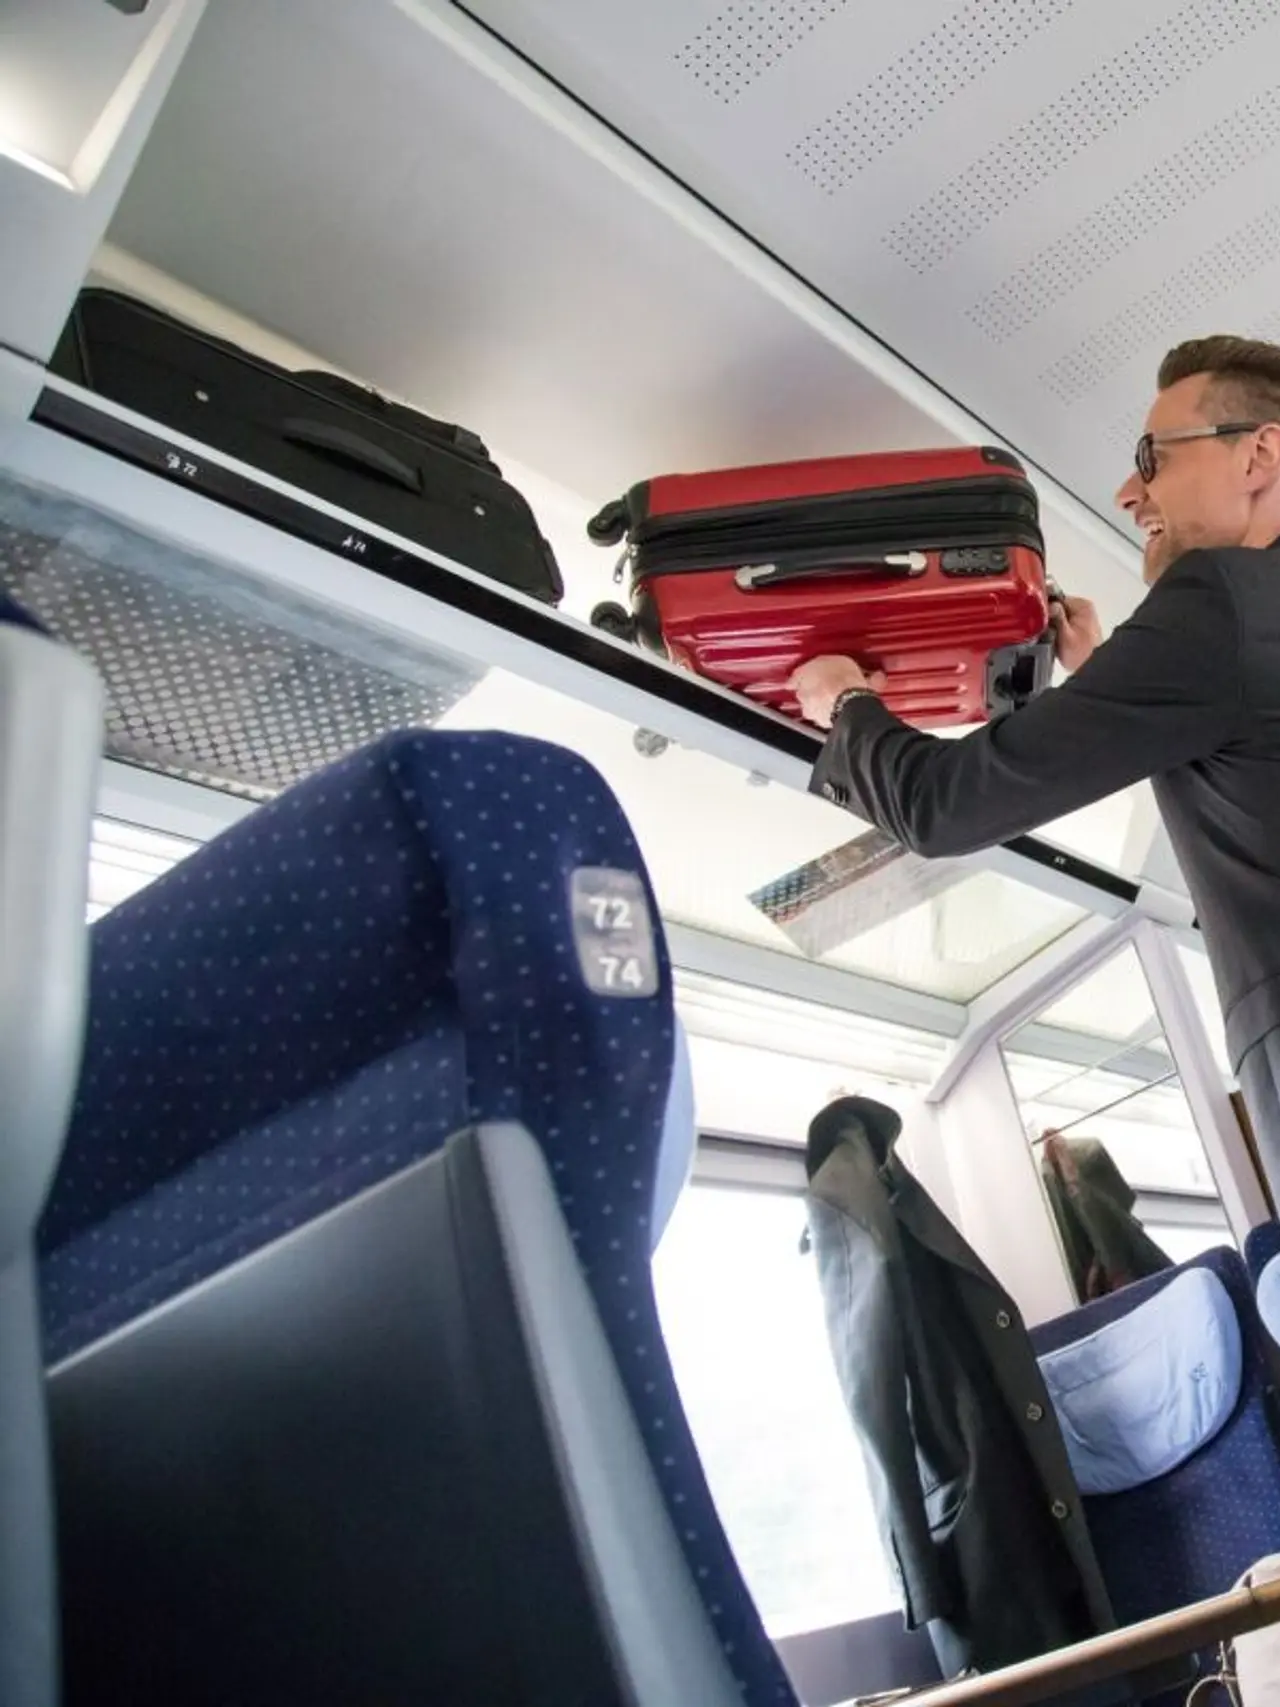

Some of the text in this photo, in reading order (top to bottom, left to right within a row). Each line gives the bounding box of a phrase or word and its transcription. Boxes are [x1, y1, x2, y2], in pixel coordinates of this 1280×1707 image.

[183, 462, 198, 477] 72
[588, 896, 634, 930] 72
[598, 956, 645, 989] 74
